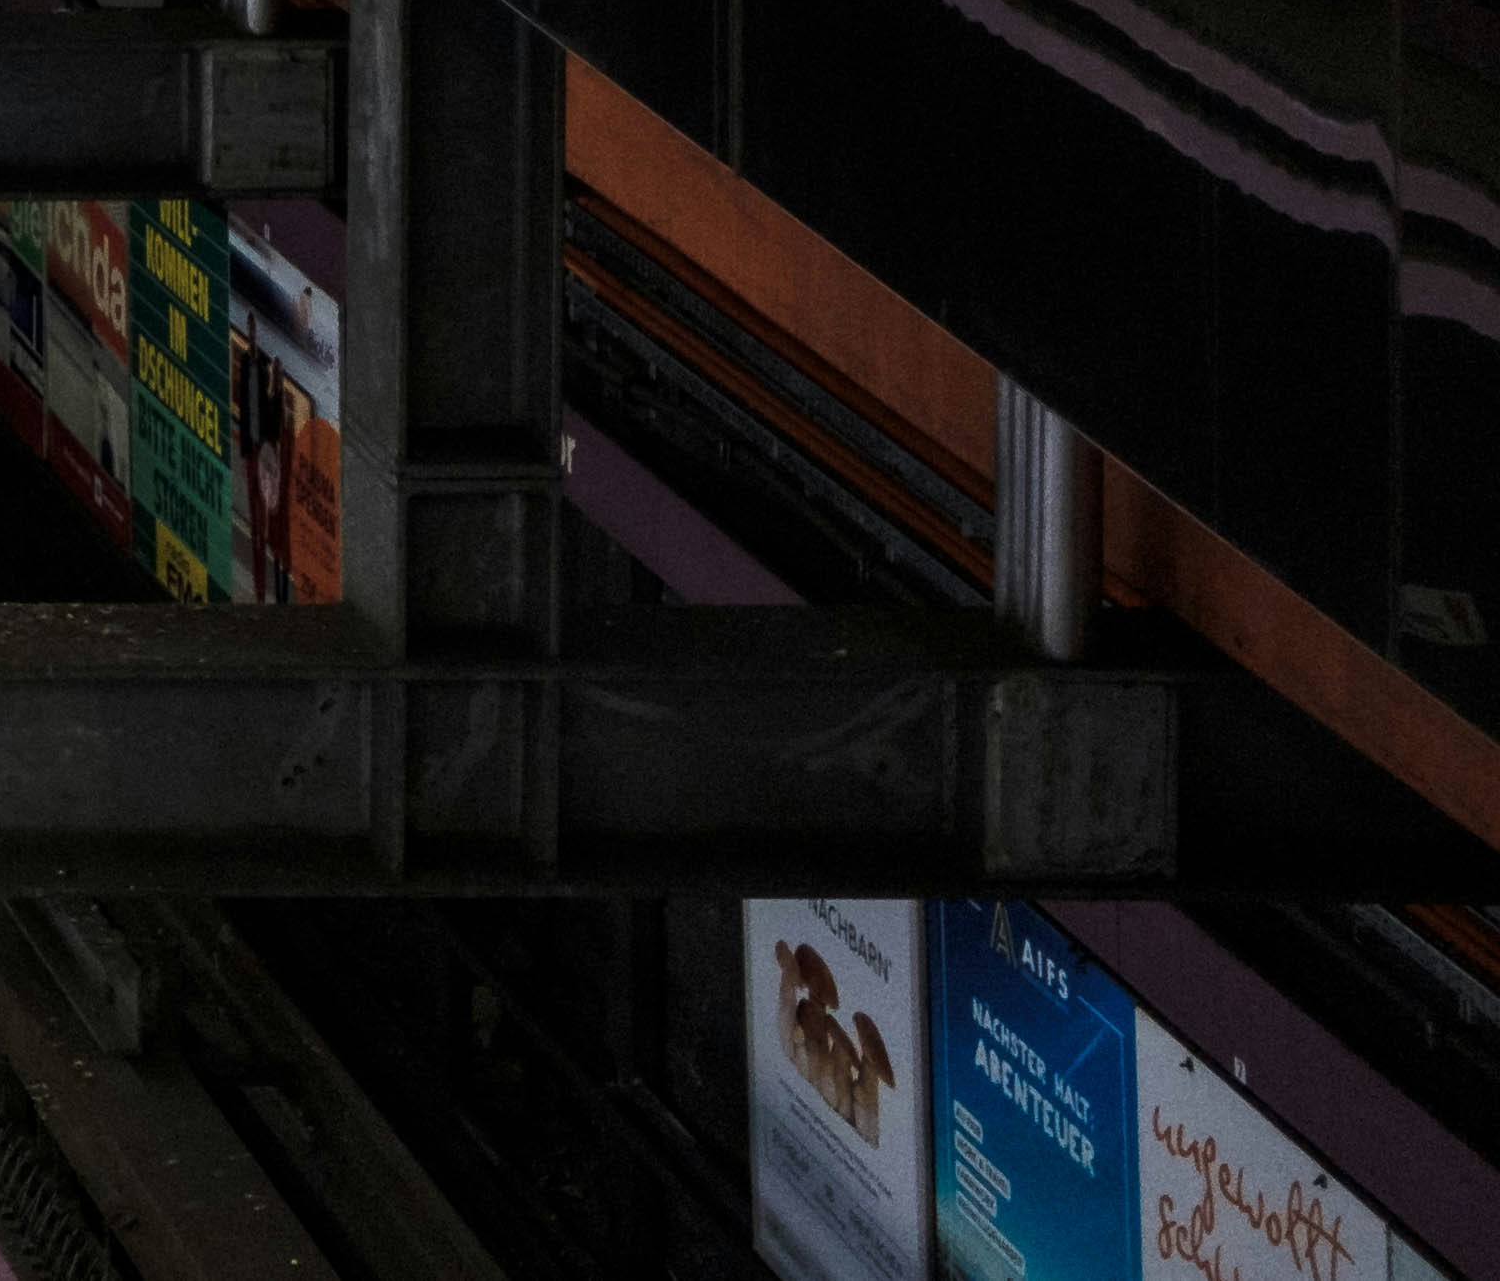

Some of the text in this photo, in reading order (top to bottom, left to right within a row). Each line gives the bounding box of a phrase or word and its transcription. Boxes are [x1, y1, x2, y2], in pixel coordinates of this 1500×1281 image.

[145, 224, 210, 323] KOMMEN
[168, 304, 188, 363] IM
[138, 334, 223, 456] DSCHUNGEL
[181, 435, 224, 517] NICHT
[1021, 938, 1070, 1001] AIFS
[974, 1038, 1096, 1178] ABENTEUER
